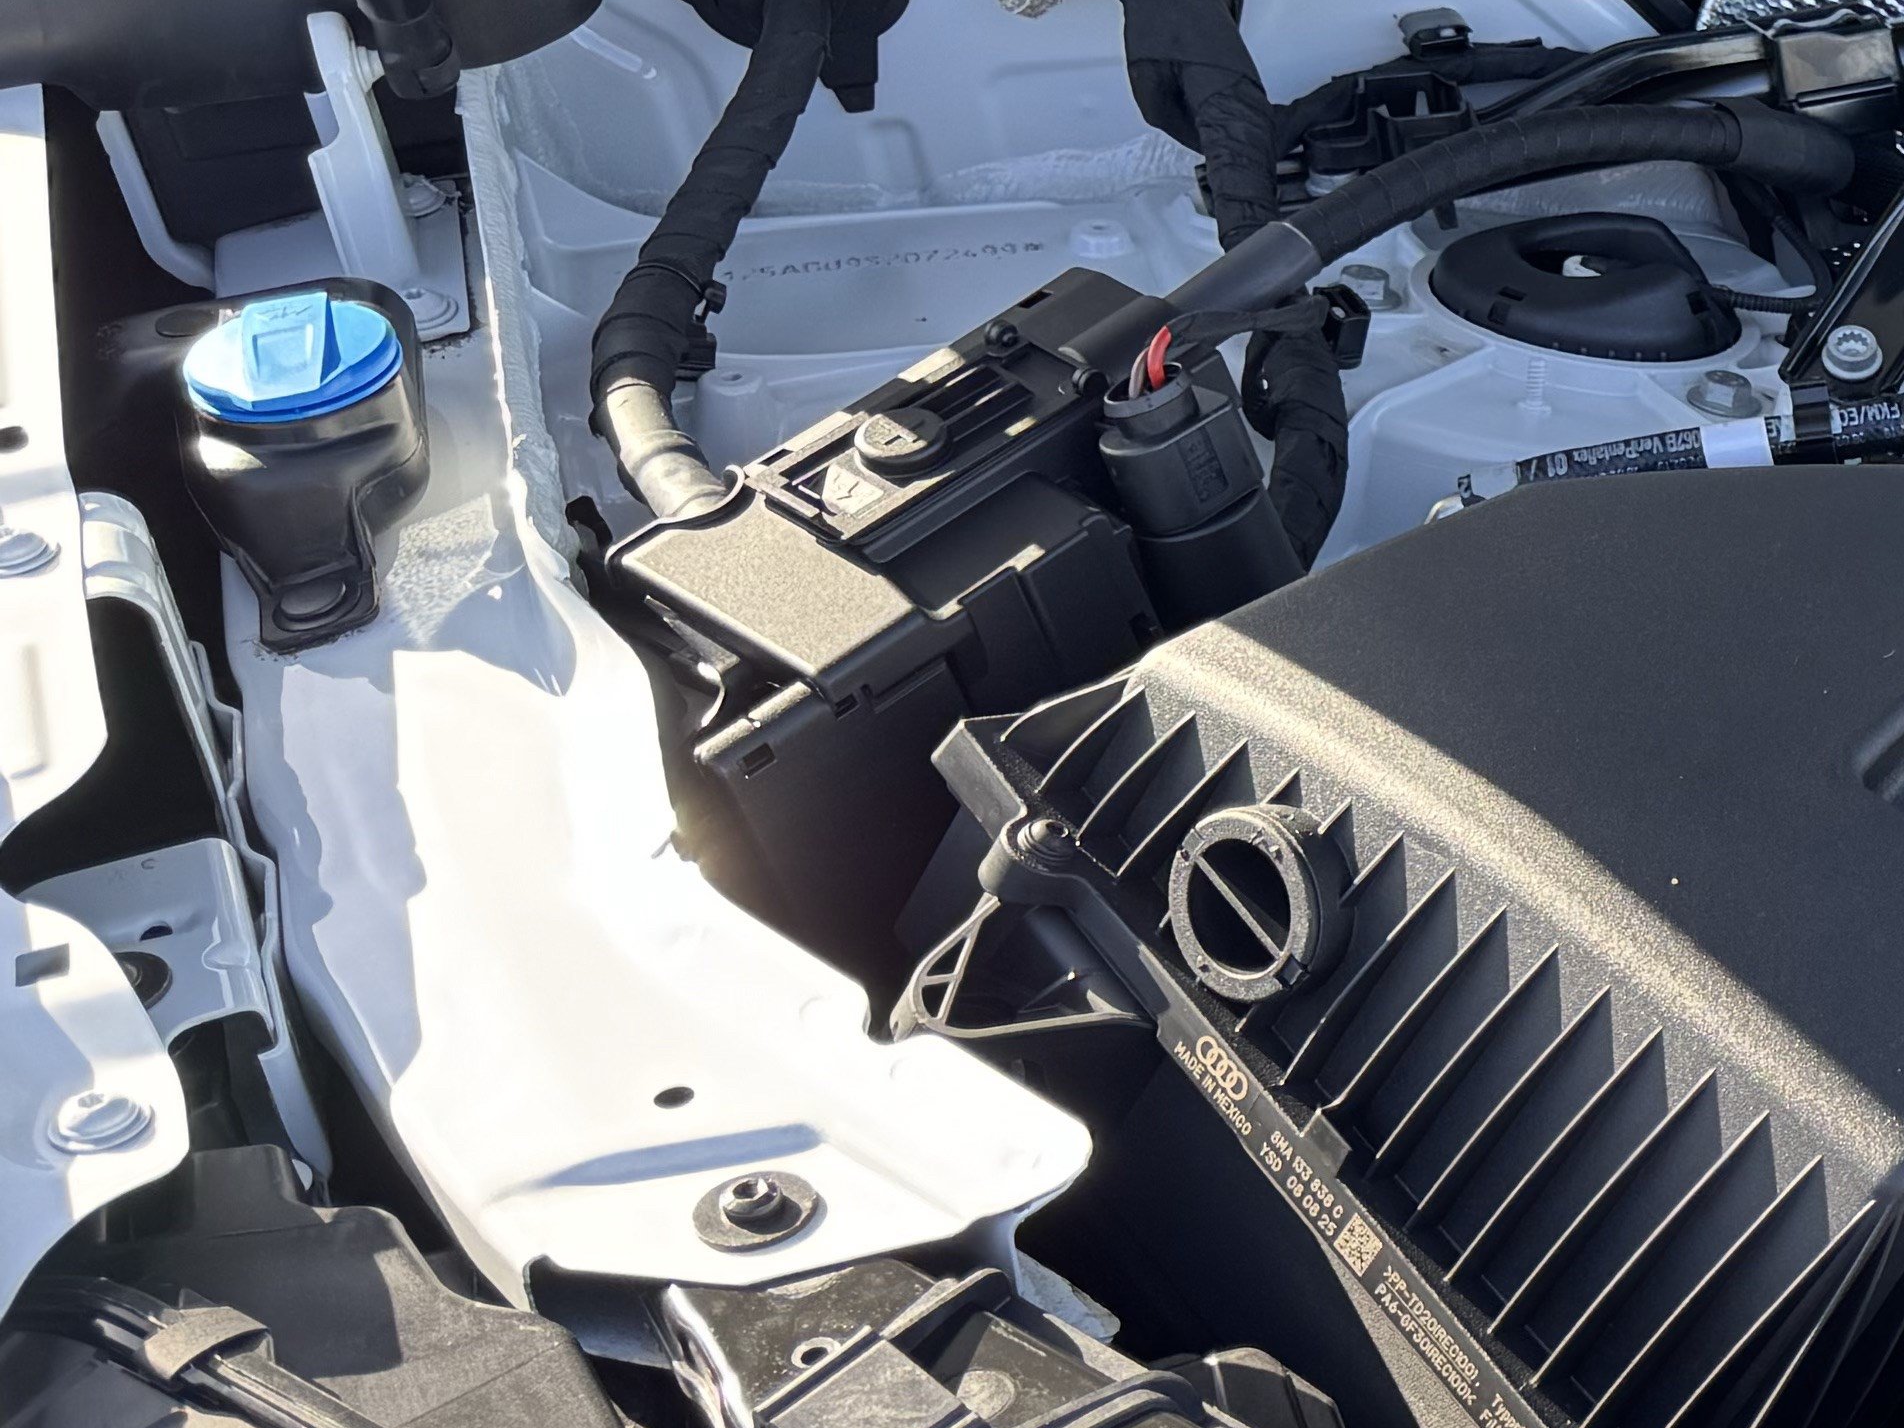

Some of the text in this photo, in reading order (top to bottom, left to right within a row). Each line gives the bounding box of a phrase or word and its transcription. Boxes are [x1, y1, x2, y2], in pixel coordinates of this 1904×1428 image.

[1170, 1039, 1255, 1136] MADE IN MEXICO
[1254, 1141, 1338, 1237] YSD 08 08 25
